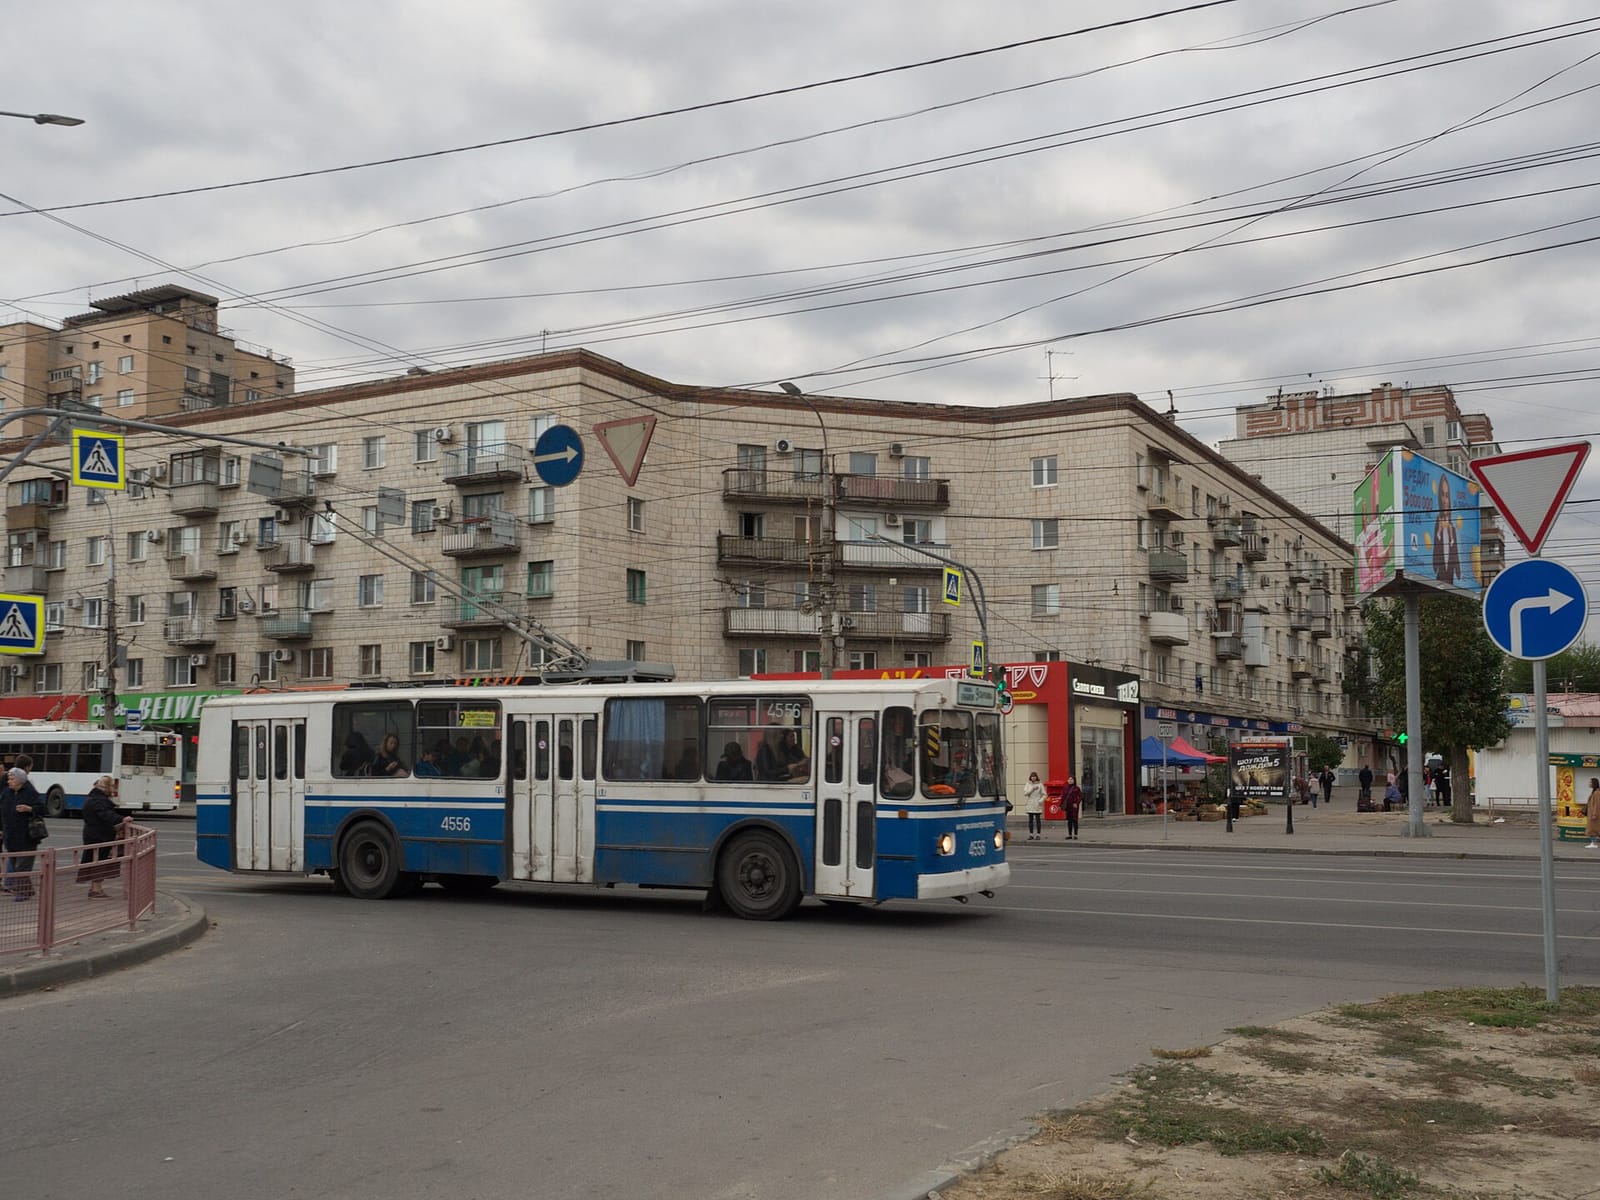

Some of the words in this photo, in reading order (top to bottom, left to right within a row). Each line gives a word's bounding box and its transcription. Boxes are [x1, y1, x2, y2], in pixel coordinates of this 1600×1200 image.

[91, 703, 127, 717] ОБВЬ
[767, 703, 801, 718] 4556
[1273, 758, 1280, 767] 5
[440, 816, 471, 831] 4556
